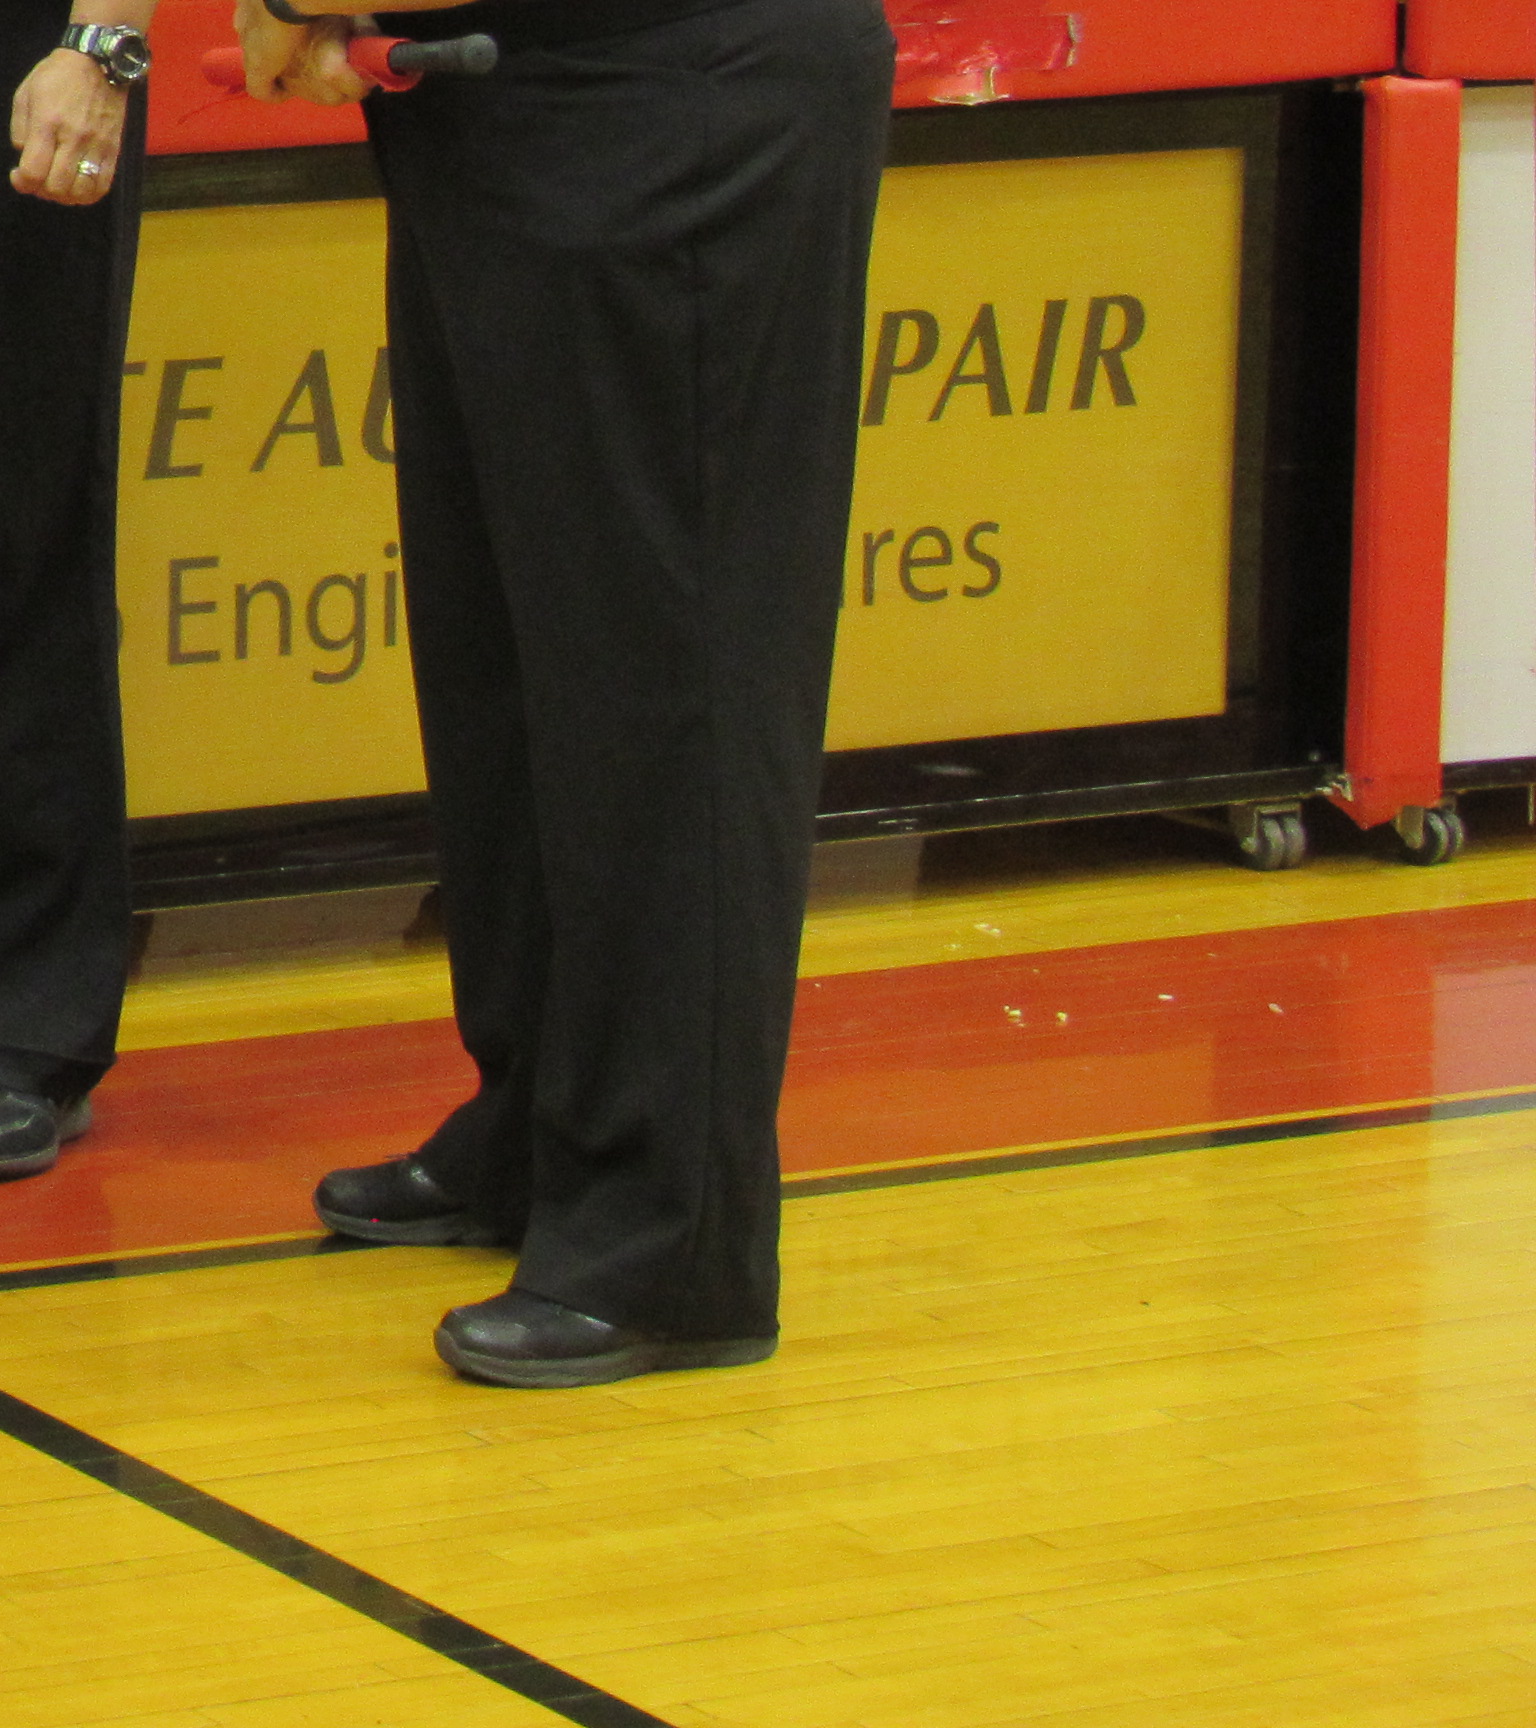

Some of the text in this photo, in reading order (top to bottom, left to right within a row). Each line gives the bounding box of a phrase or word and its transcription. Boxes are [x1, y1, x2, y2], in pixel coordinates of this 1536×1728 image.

[860, 293, 1147, 428] PAIR
[167, 541, 399, 685] Engi
[861, 520, 1002, 607] res
